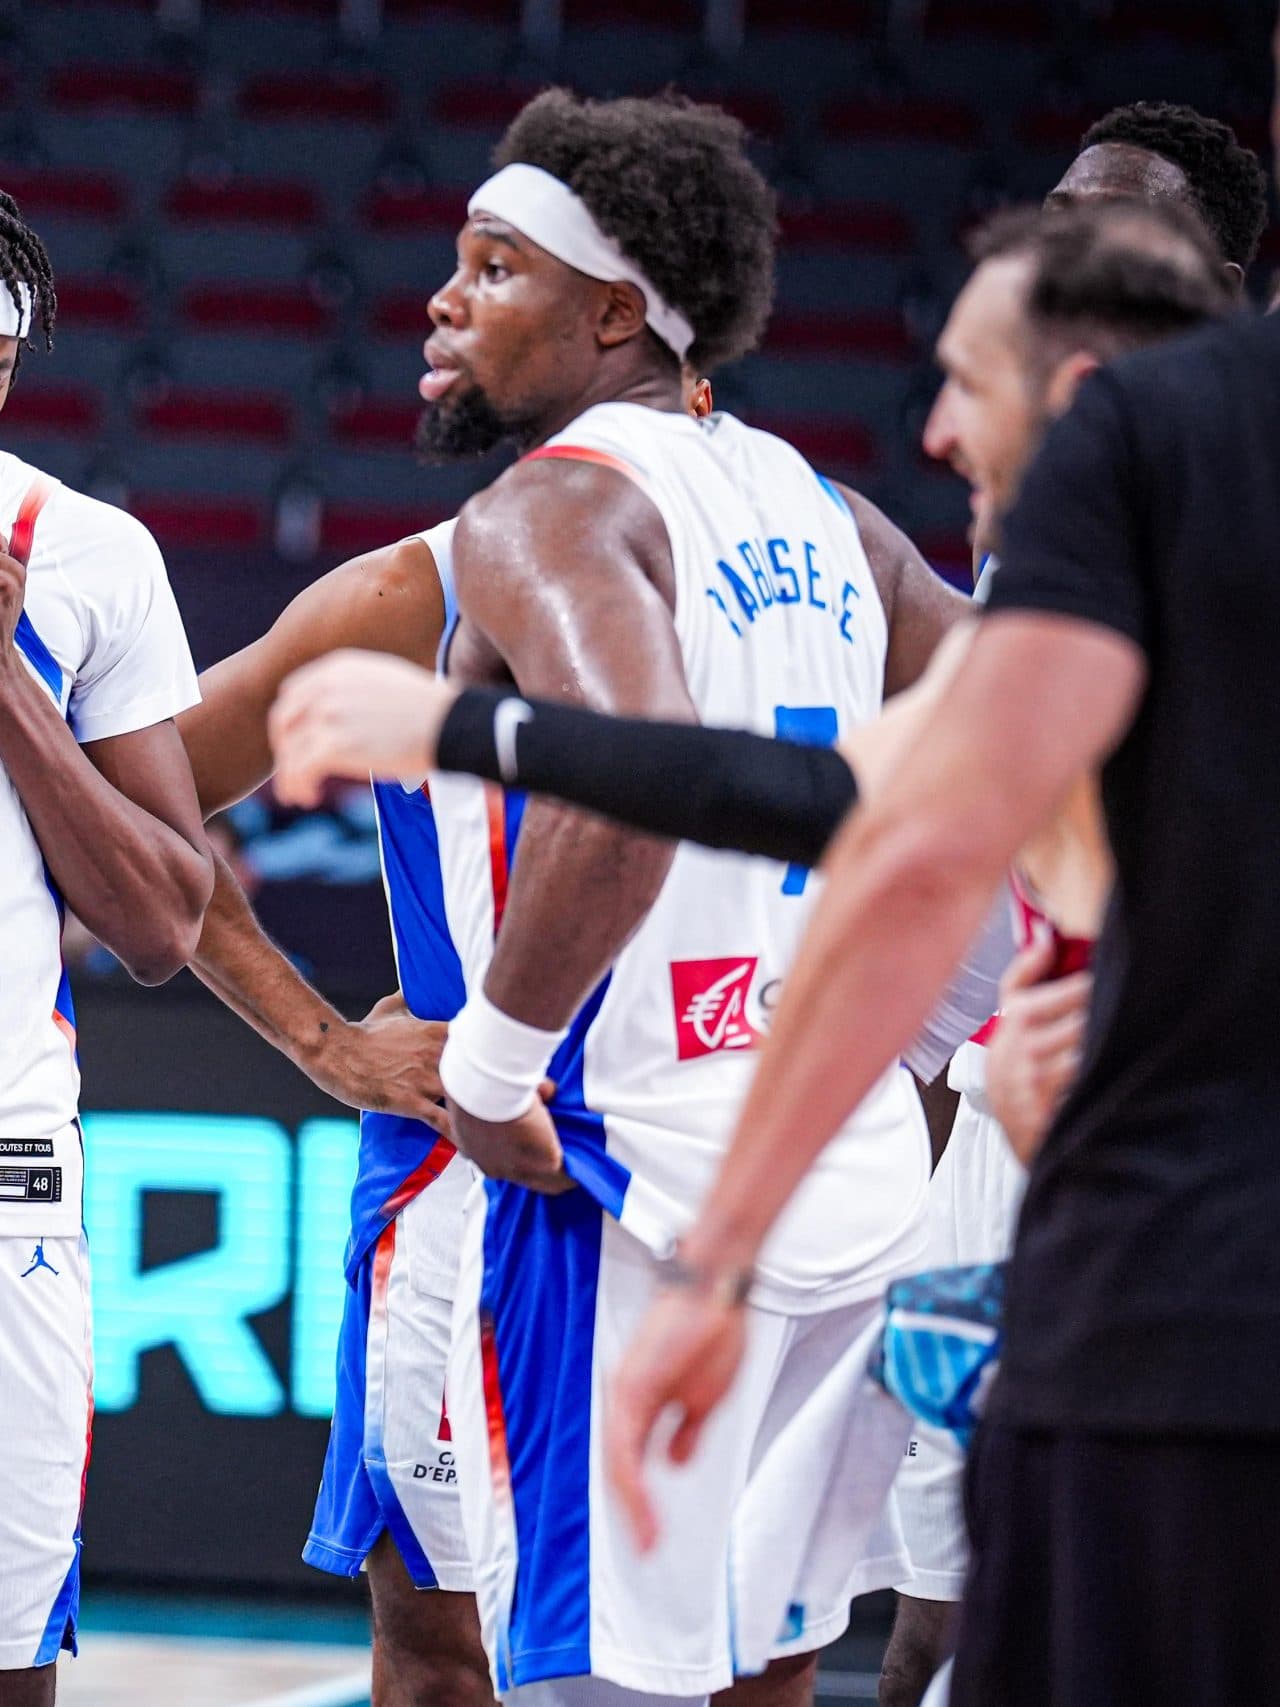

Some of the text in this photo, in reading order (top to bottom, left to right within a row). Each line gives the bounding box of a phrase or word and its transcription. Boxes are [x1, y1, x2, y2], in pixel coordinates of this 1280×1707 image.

[24, 1143, 33, 1152] ET
[34, 1144, 52, 1152] TOUS
[32, 1177, 49, 1191] 48
